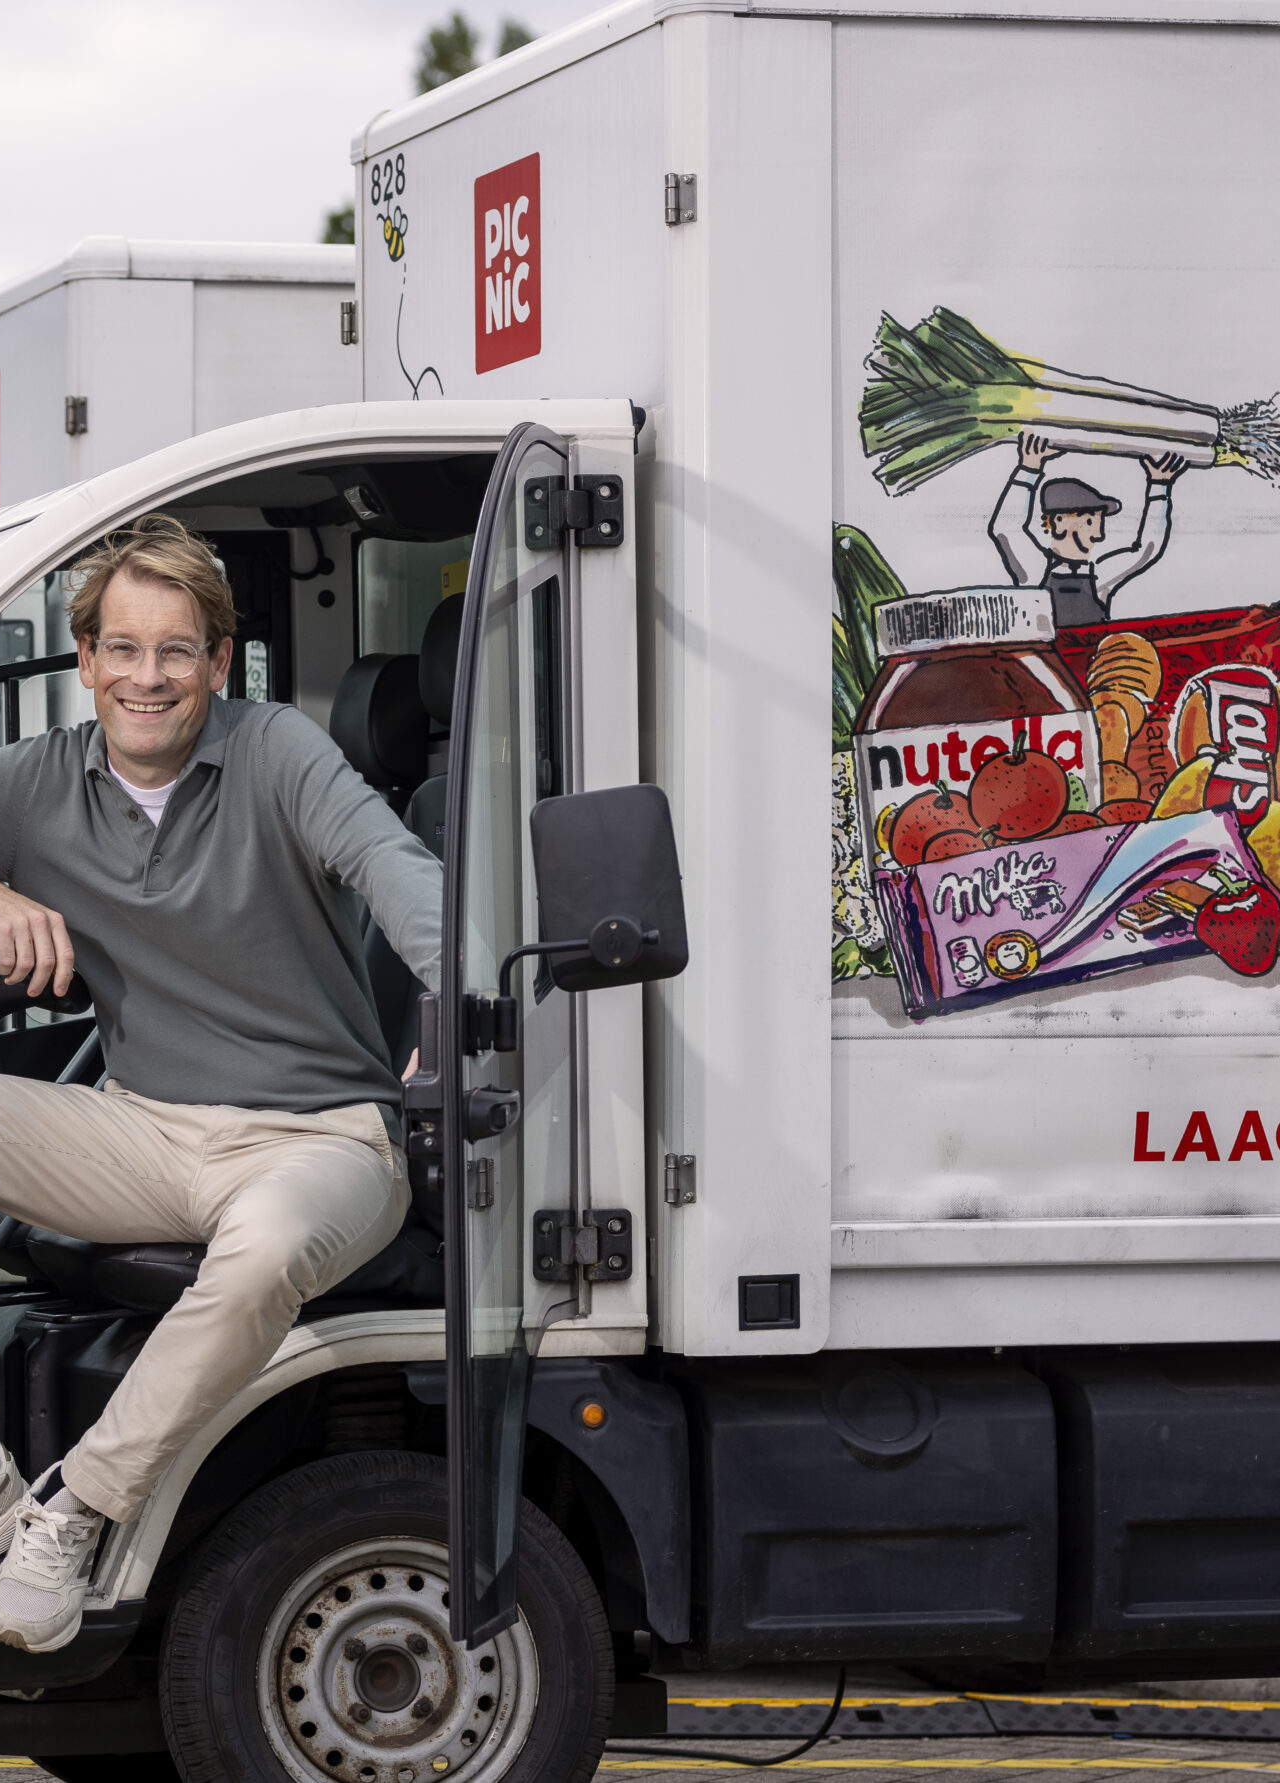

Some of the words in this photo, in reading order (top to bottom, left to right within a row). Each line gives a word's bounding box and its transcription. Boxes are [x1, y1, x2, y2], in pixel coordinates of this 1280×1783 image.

[370, 152, 406, 206] 828
[484, 195, 530, 269] PIC
[933, 851, 1056, 923] Milka
[1133, 1110, 1280, 1162] LAA
